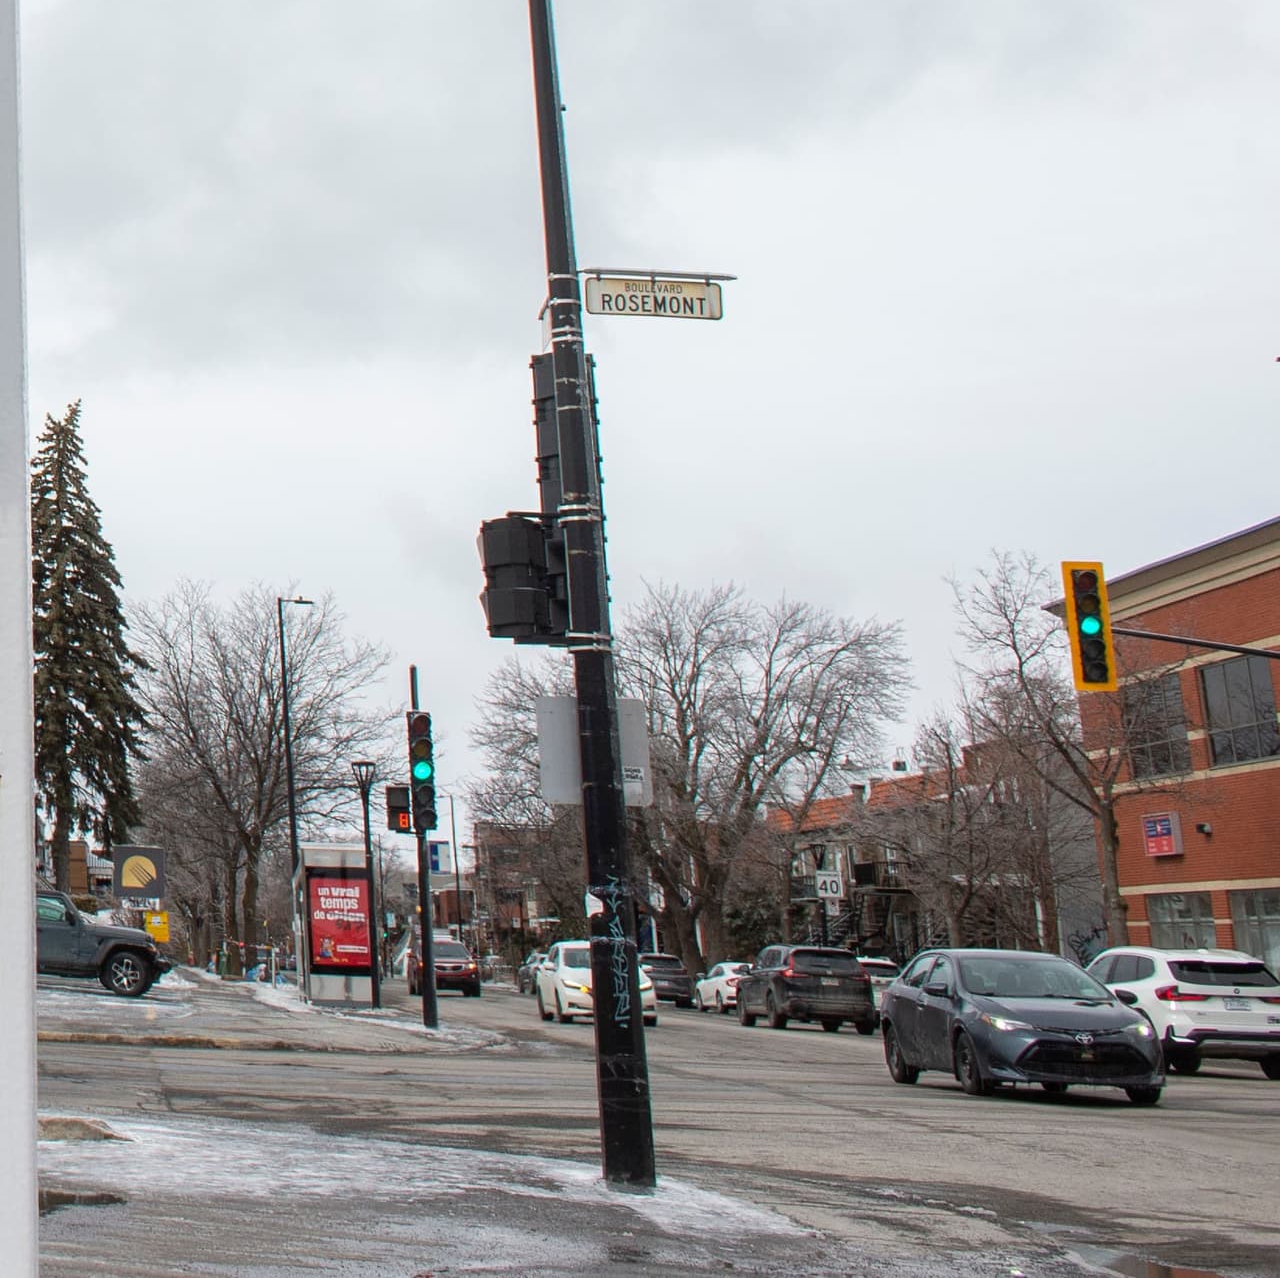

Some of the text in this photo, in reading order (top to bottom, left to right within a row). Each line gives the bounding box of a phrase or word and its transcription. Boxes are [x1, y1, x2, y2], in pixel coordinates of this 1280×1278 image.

[624, 282, 682, 294] BOULEVARD
[602, 294, 706, 315] ROSEMONT
[318, 887, 360, 898] un vrai
[819, 880, 839, 894] 40
[320, 896, 359, 914] temps
[314, 909, 326, 920] de
